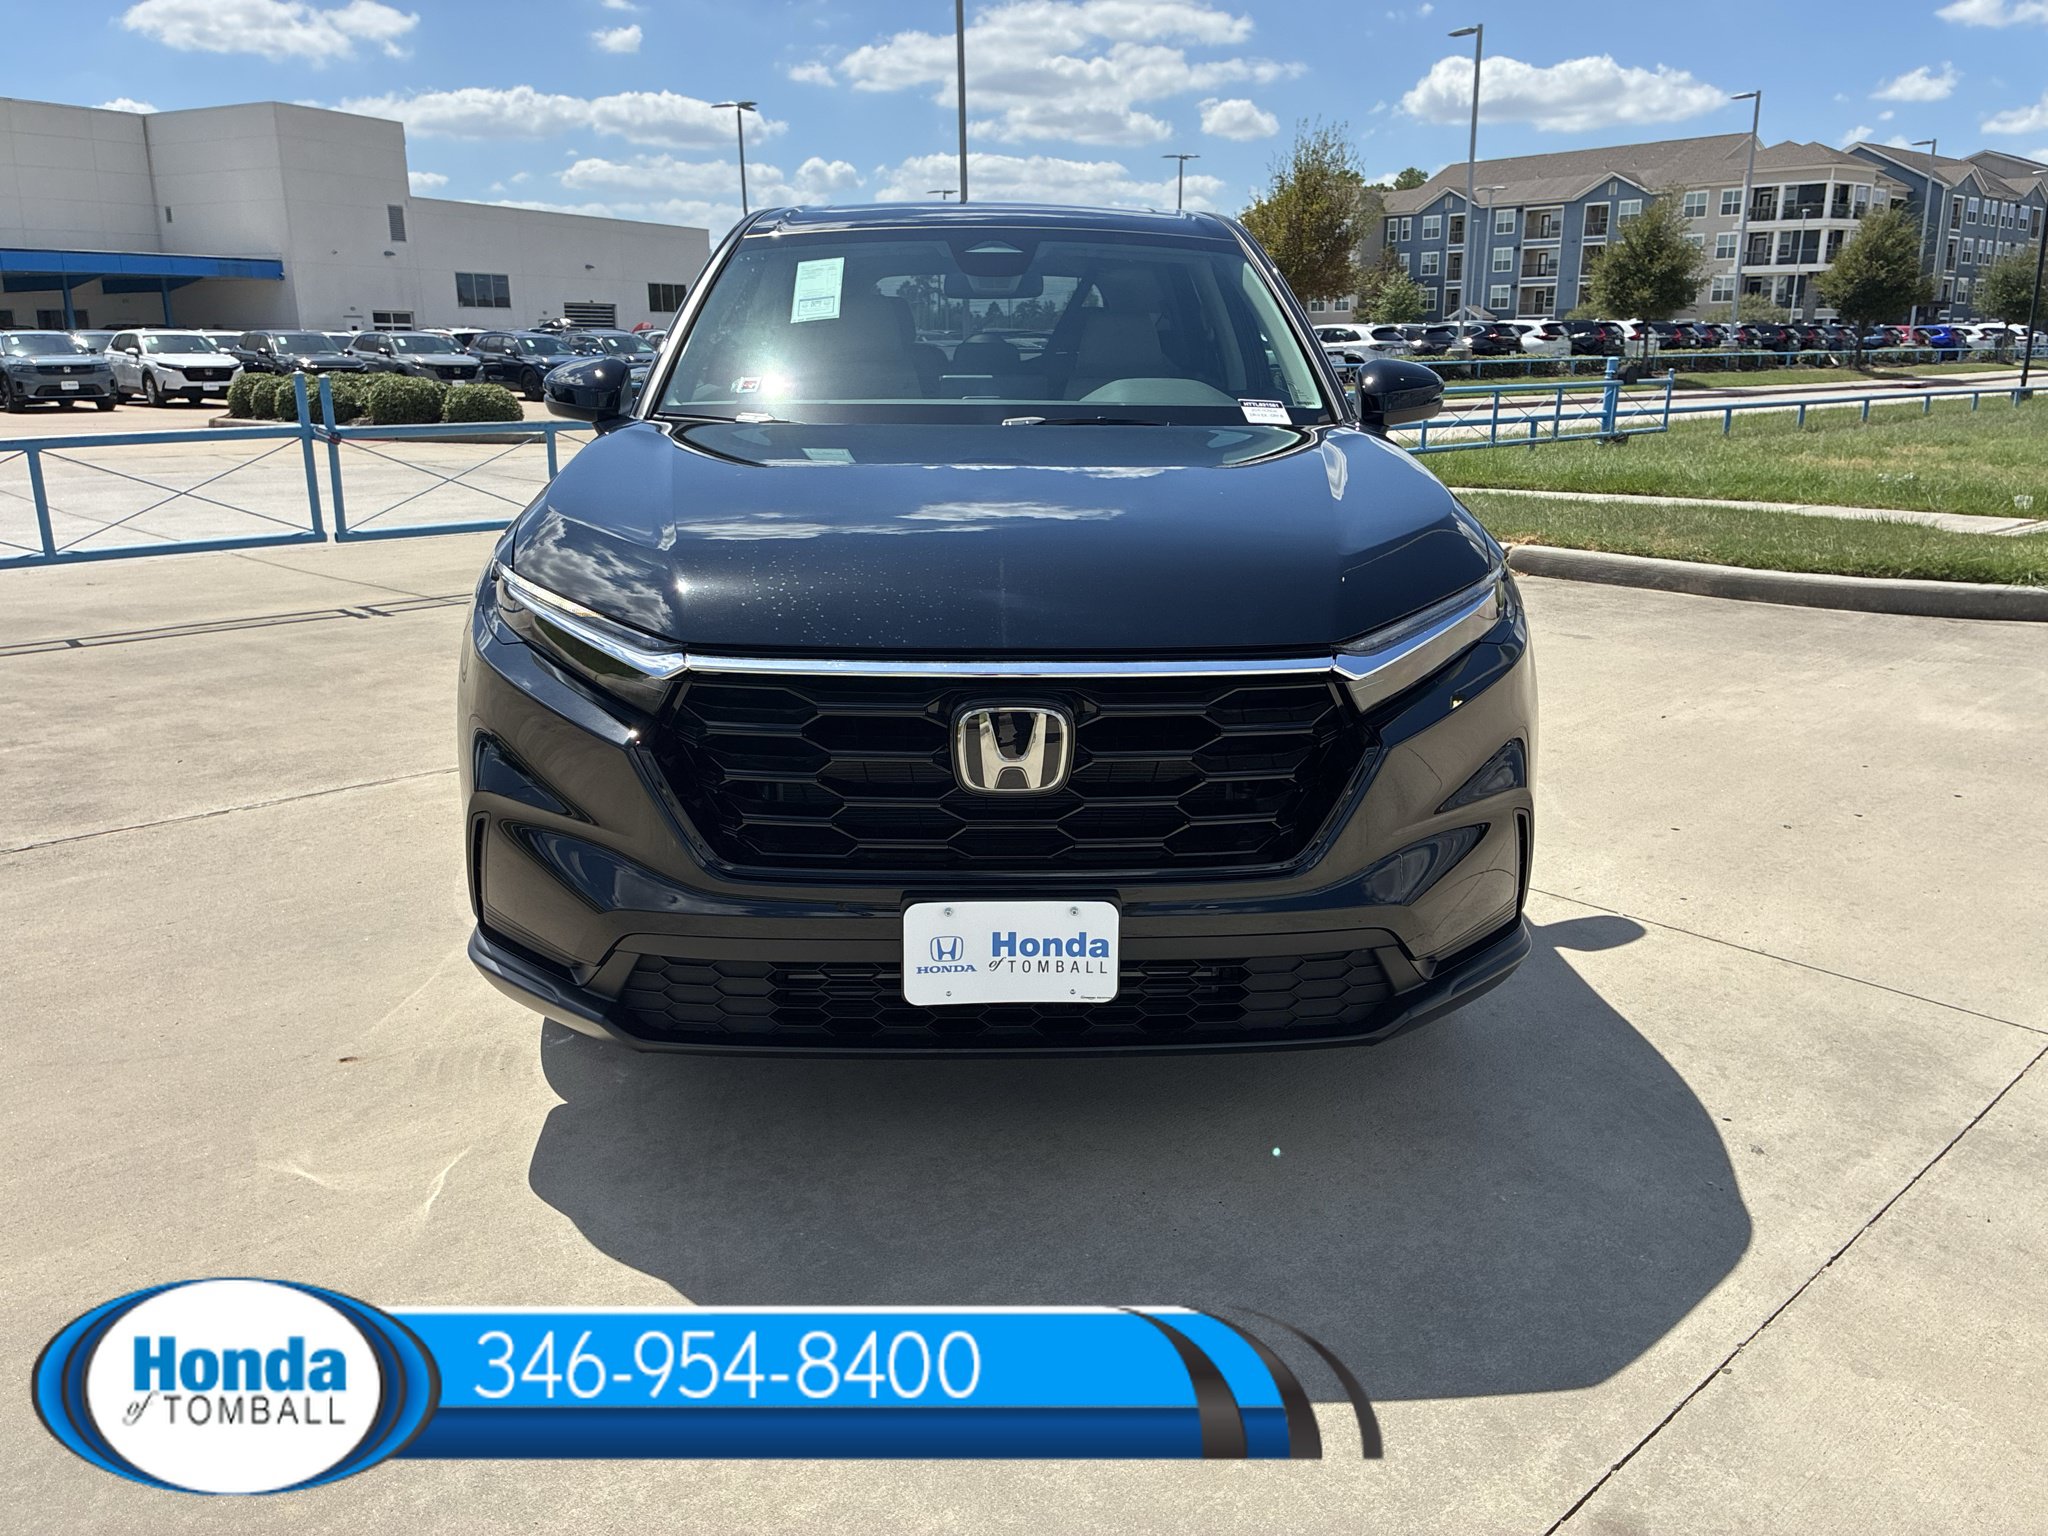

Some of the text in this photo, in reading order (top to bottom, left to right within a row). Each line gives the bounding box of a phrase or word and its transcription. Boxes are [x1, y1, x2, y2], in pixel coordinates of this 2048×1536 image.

[992, 932, 1110, 958] Honda
[916, 964, 977, 975] HONDA
[988, 957, 1108, 974] of TOMBALL
